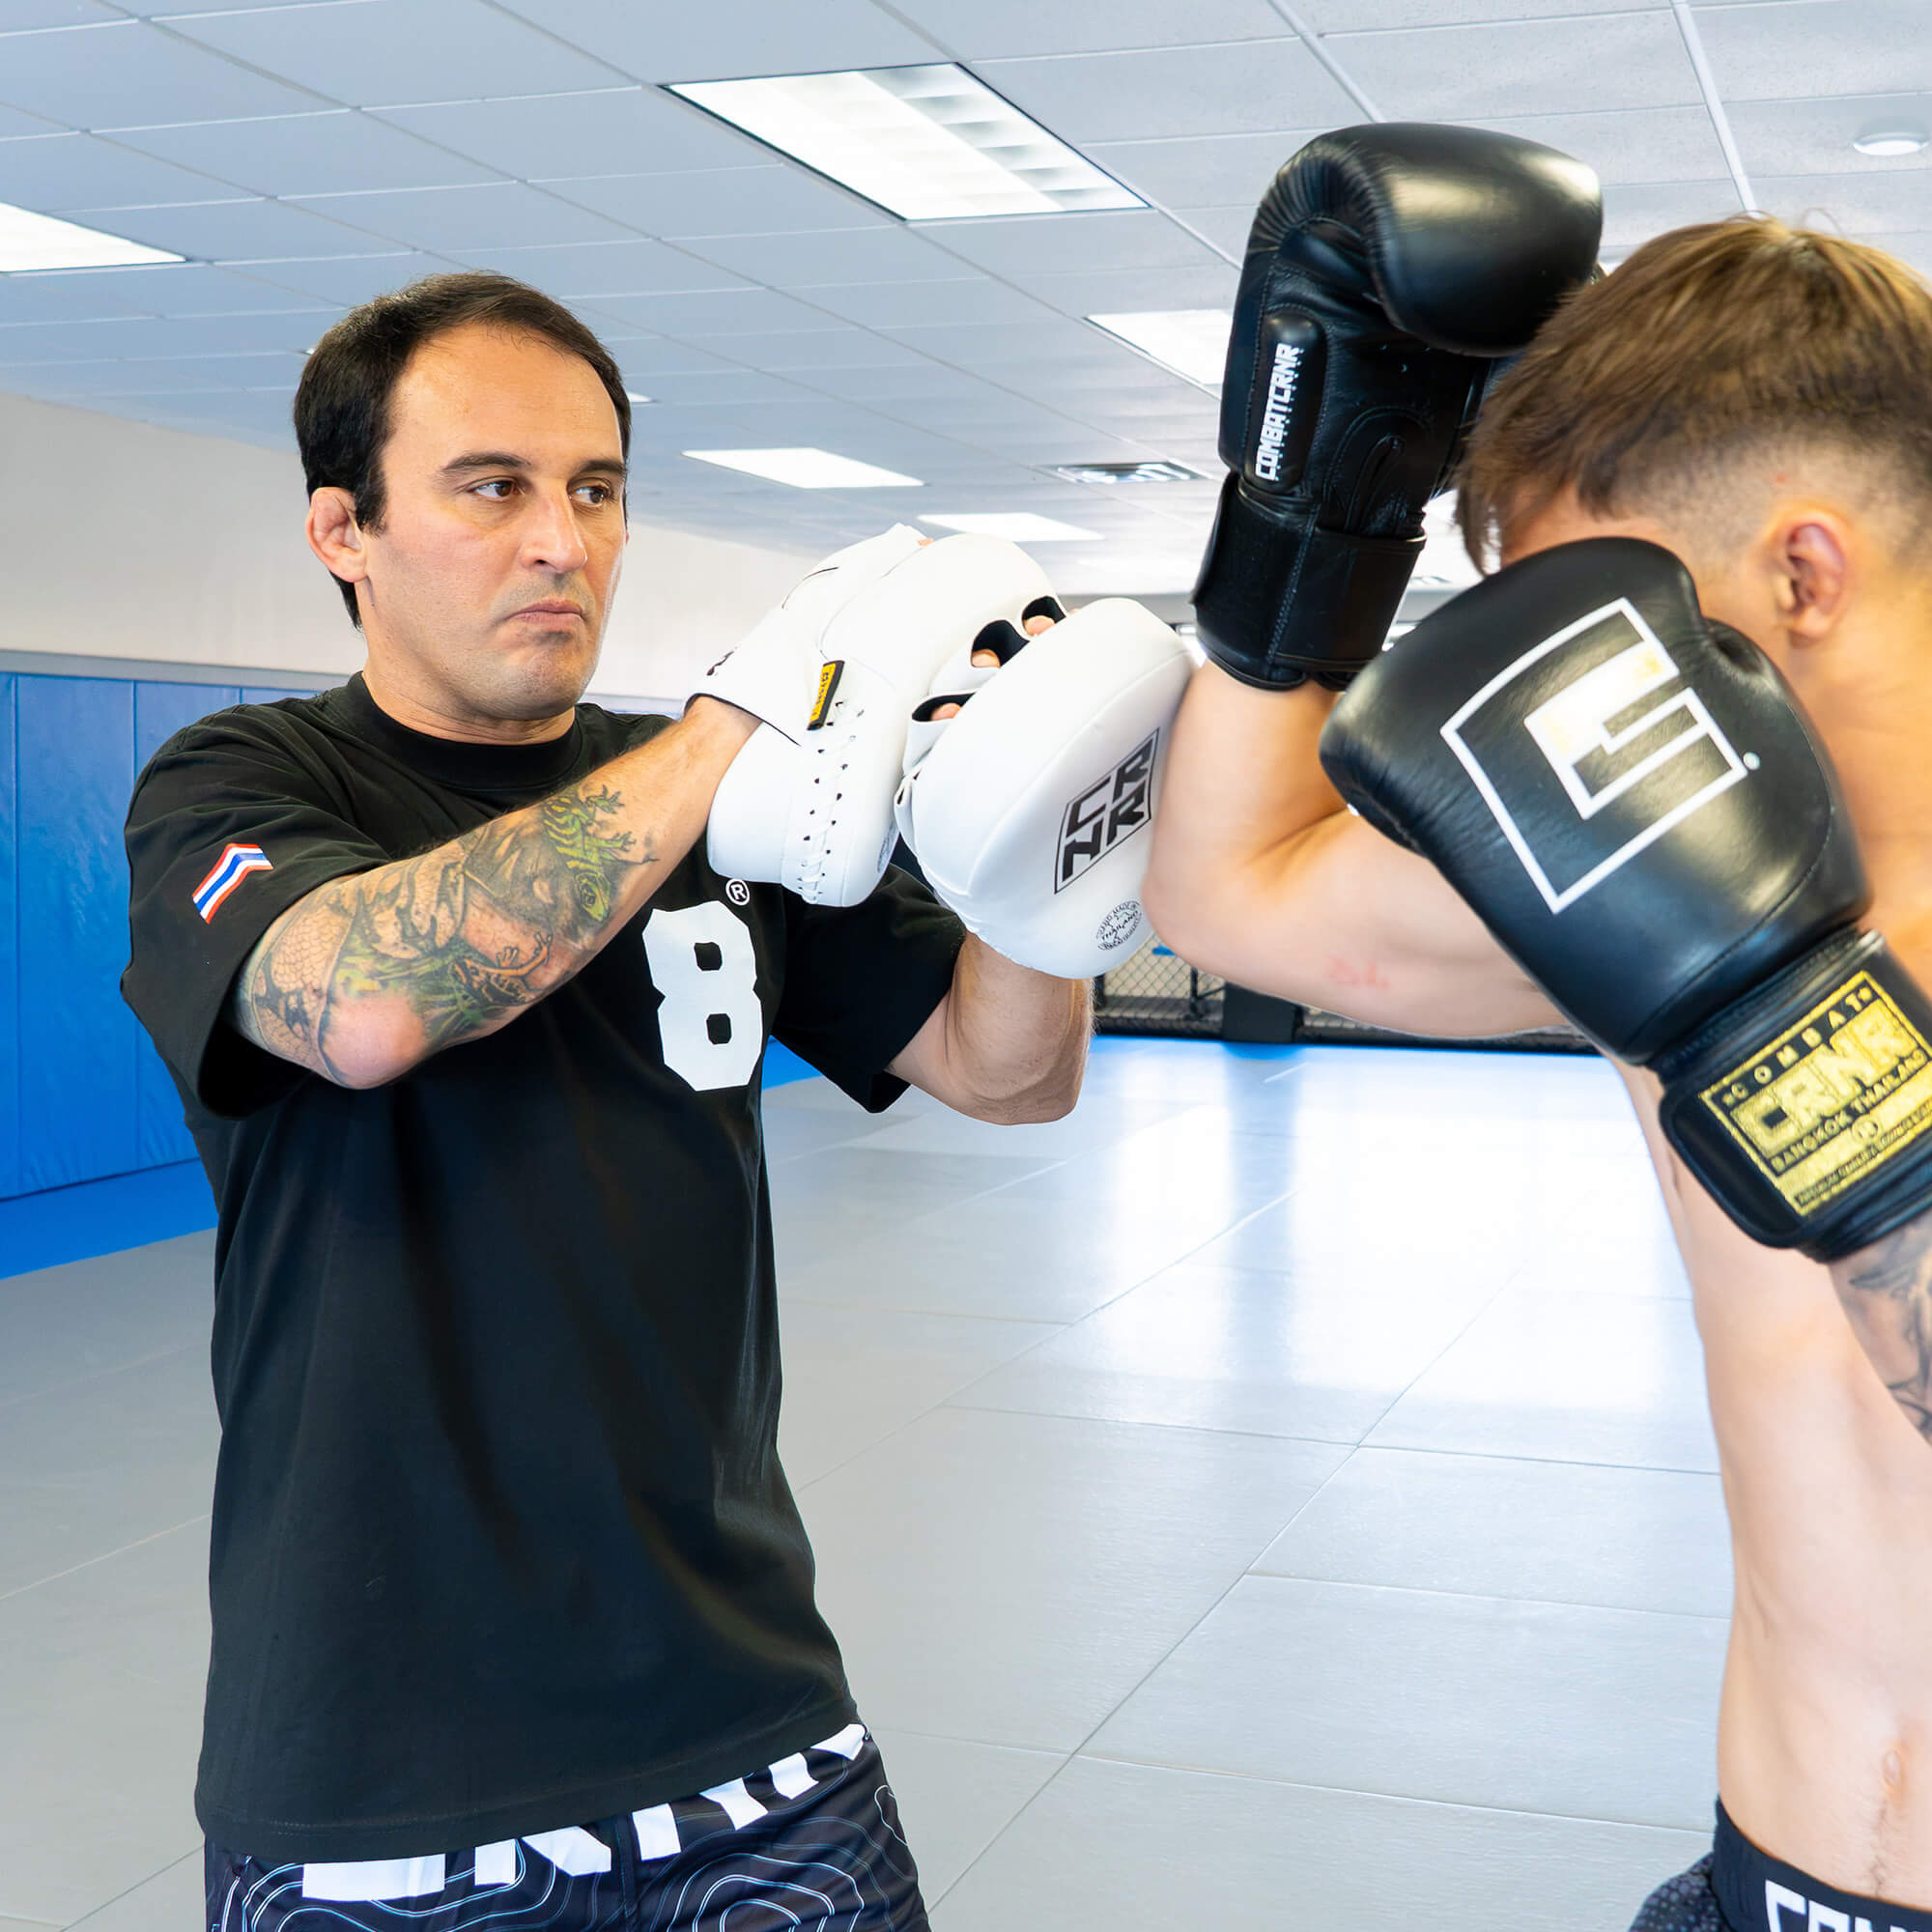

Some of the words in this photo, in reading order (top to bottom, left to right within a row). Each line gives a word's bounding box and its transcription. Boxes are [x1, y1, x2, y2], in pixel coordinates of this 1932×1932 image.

[1256, 343, 1303, 481] COMBATCRNR
[642, 900, 763, 1092] 8
[1730, 992, 1863, 1099] COMBAT
[1730, 998, 1918, 1159] CRNR
